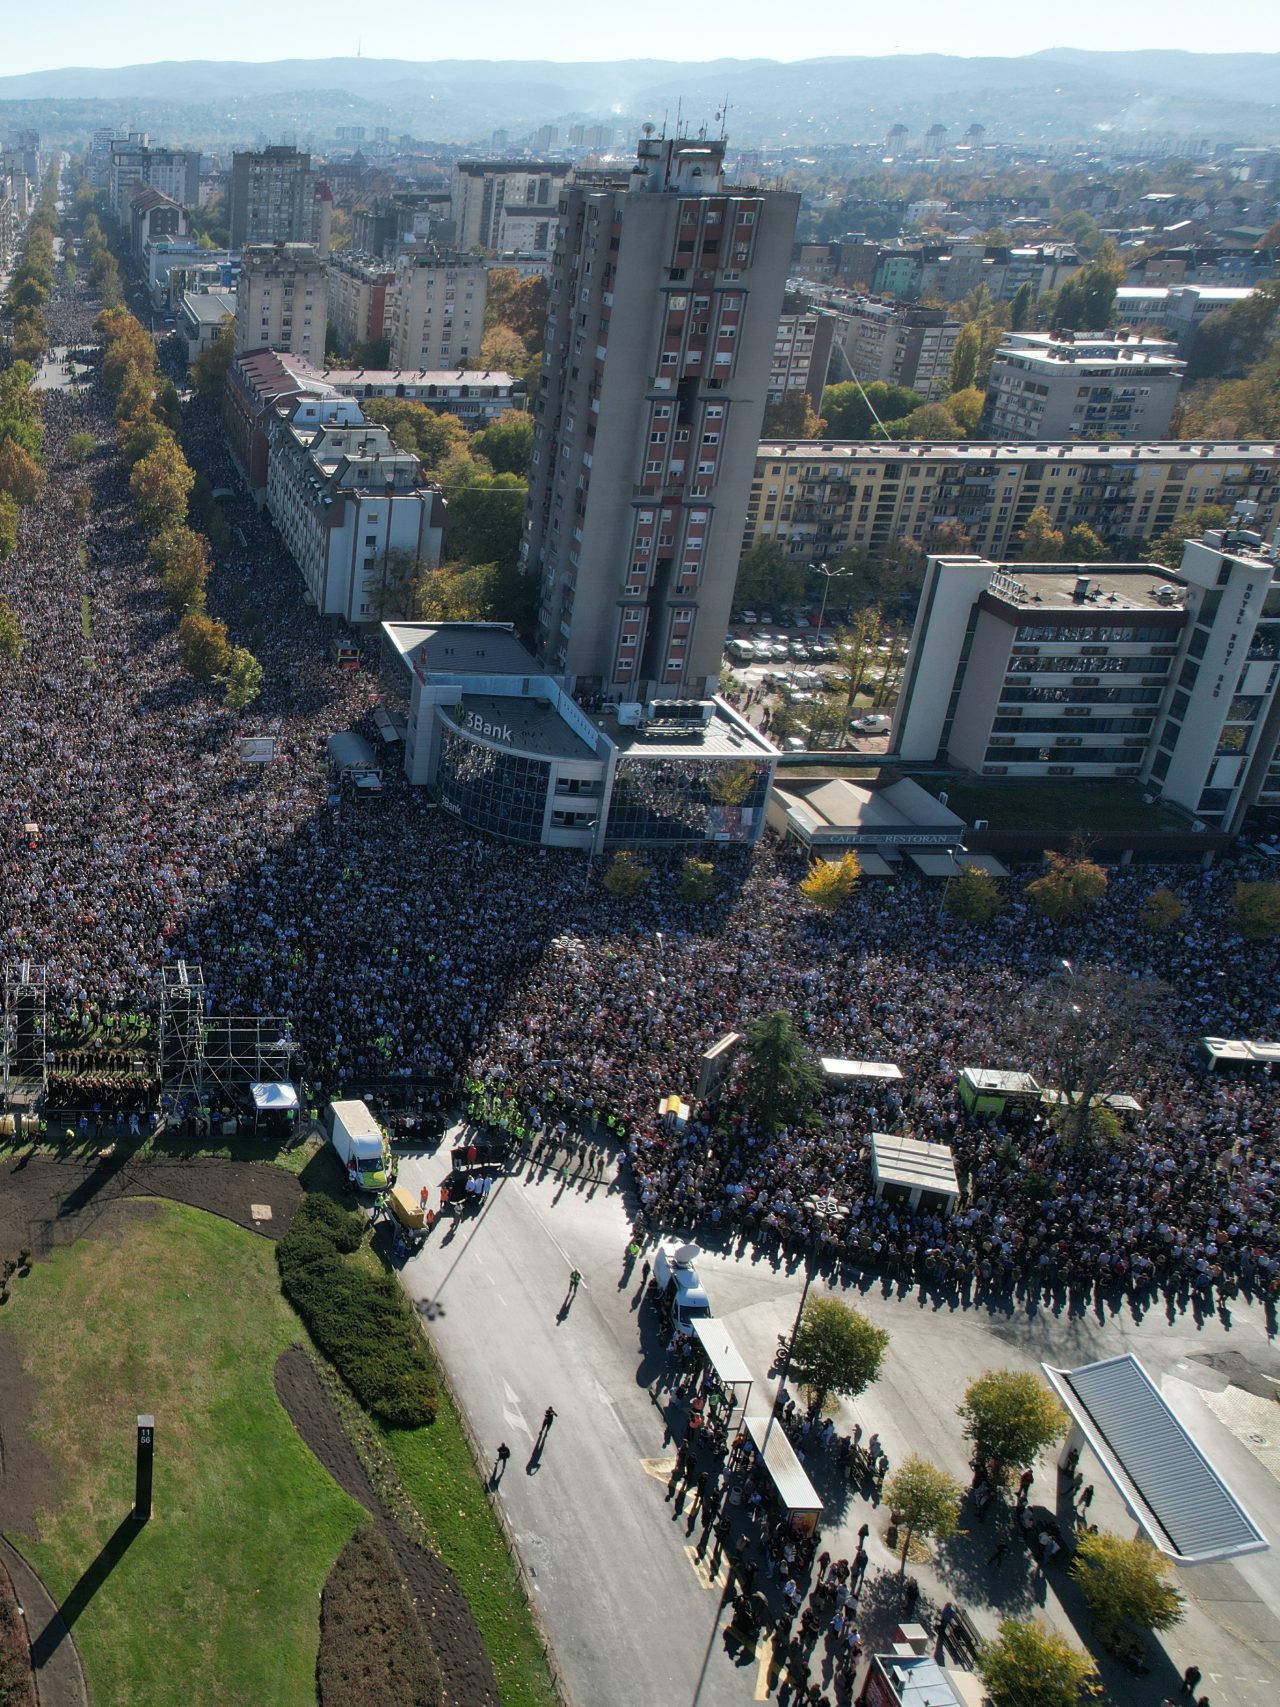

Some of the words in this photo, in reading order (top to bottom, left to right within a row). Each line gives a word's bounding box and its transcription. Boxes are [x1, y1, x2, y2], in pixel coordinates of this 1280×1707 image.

[1236, 583, 1254, 625] HOTEL
[1223, 633, 1238, 666] NOVI
[1212, 674, 1224, 698] SAD
[466, 711, 512, 742] 3Bank
[441, 795, 462, 816] 3Bank
[830, 835, 865, 843] CAFFE
[885, 834, 947, 843] RESTORAN
[140, 1436, 151, 1444] 56
